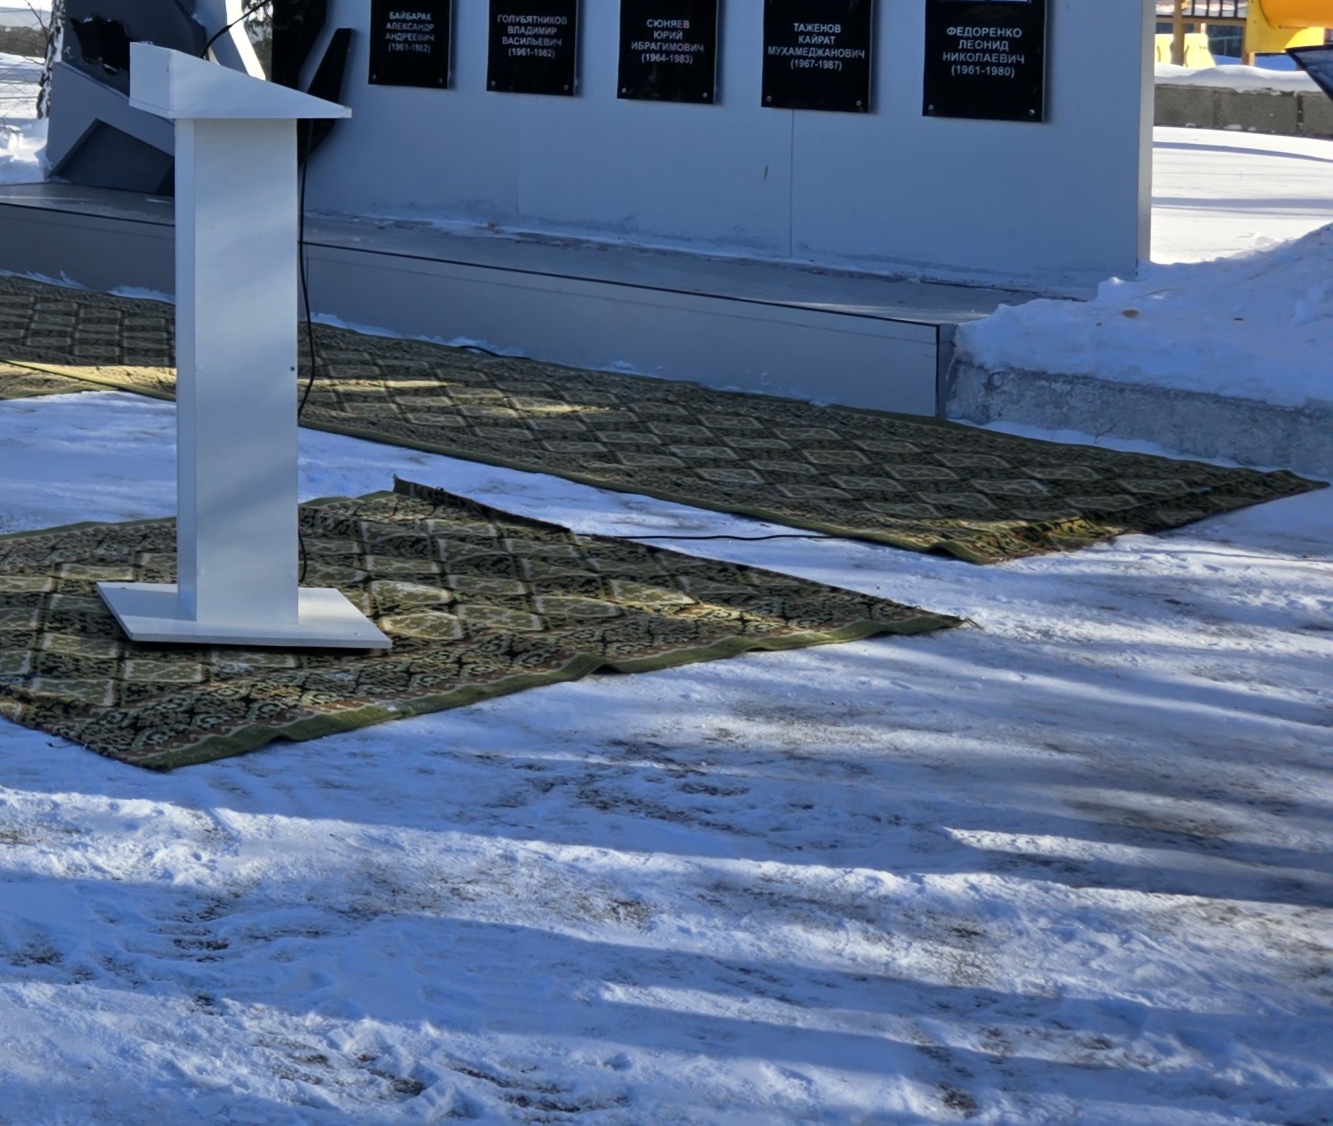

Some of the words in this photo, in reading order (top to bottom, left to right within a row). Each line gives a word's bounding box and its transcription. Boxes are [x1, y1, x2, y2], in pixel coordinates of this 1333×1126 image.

[497, 14, 568, 25] ГОЛУБЯТНИКОВ
[646, 19, 690, 29] СЮНЯЕВ
[386, 22, 435, 32] АЛЕКСАНДР
[507, 26, 557, 36] ВЛАДИМИР
[793, 23, 841, 33] ТАЖЕНОВ
[946, 26, 1022, 38] ФЕДОРЕНКО
[653, 30, 683, 40] ЮРИЙ
[799, 34, 836, 45] КАЙРАТ
[502, 36, 562, 47] ВАСИЛЬЕВИЧ
[631, 41, 704, 53] ИБРАГИМОВИЧ
[958, 39, 1009, 52] ЛЕОНИД
[768, 46, 865, 59] МУХАМЕДЖАНОВИЧ
[942, 52, 1025, 64] НИКОЛАЕВИЧ
[790, 59, 842, 71] (1967-1987)
[951, 64, 1015, 78] (1961-1980)
